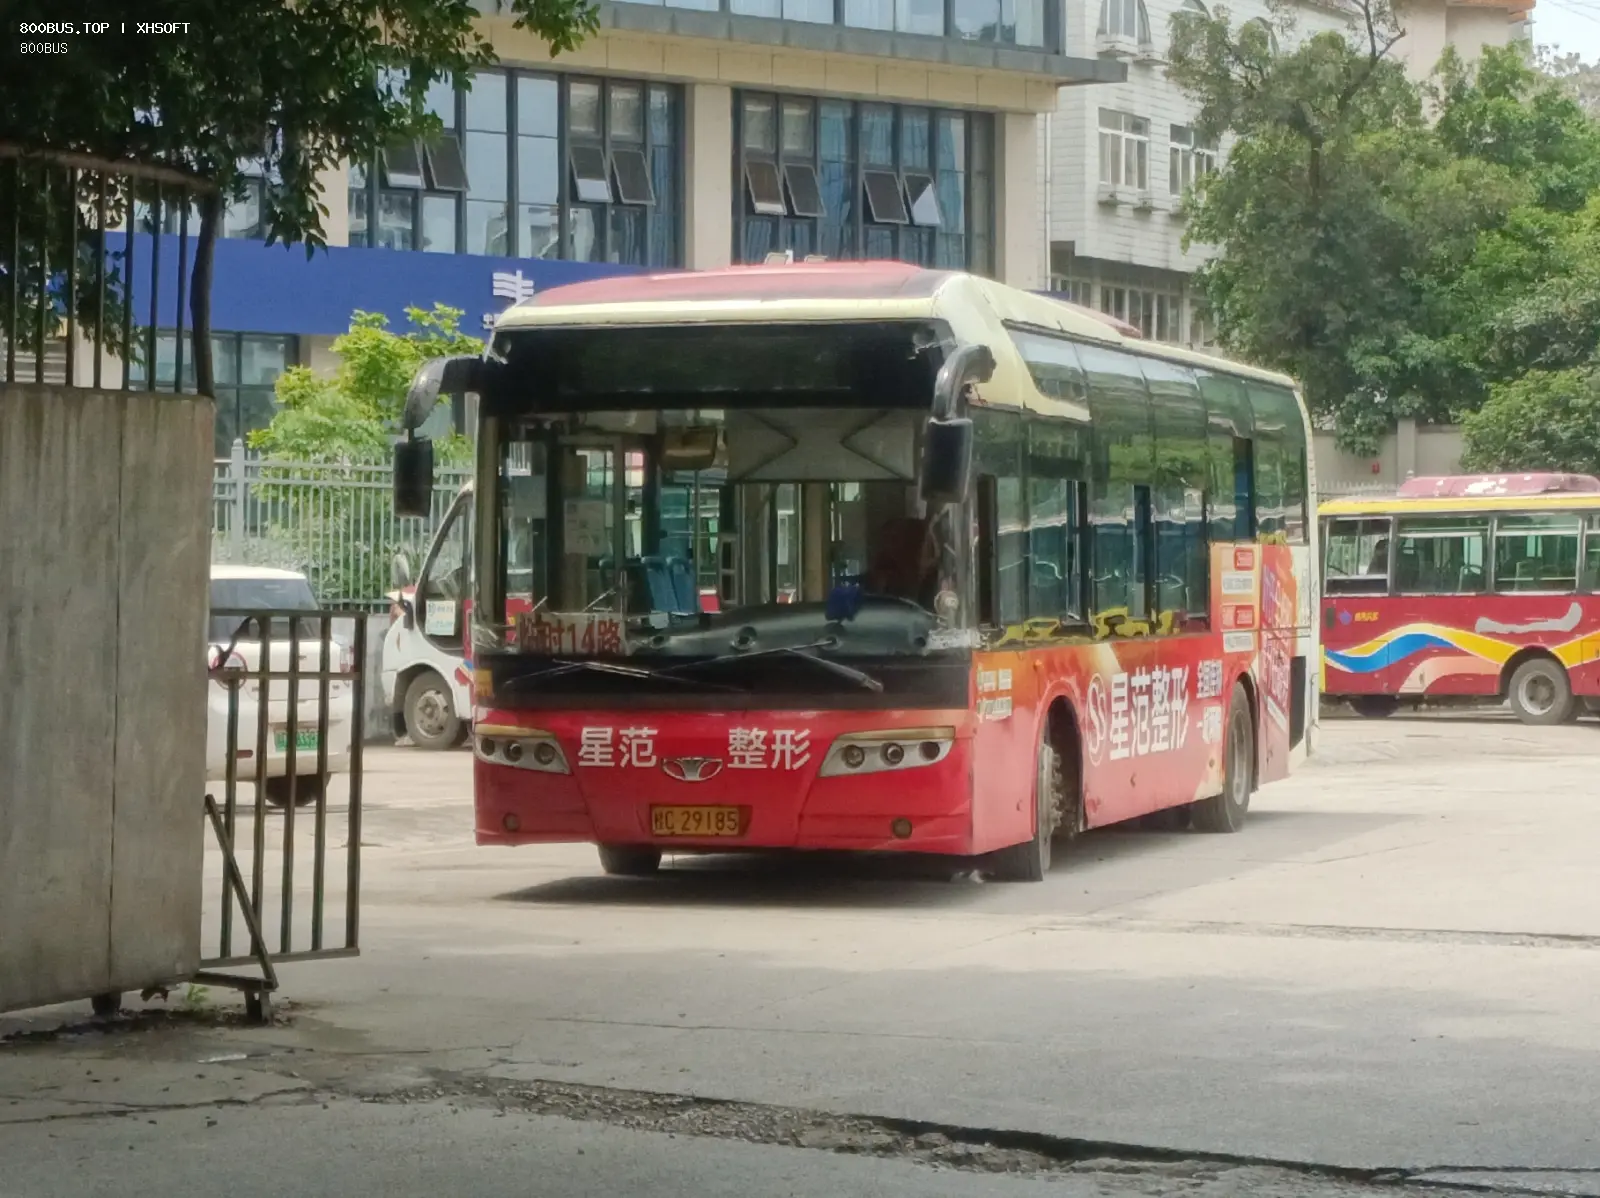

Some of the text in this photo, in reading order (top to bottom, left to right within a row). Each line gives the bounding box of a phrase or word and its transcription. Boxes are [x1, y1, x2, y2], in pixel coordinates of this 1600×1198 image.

[1110, 664, 1189, 760] 星范整形
[578, 727, 811, 770] 星范 整形
